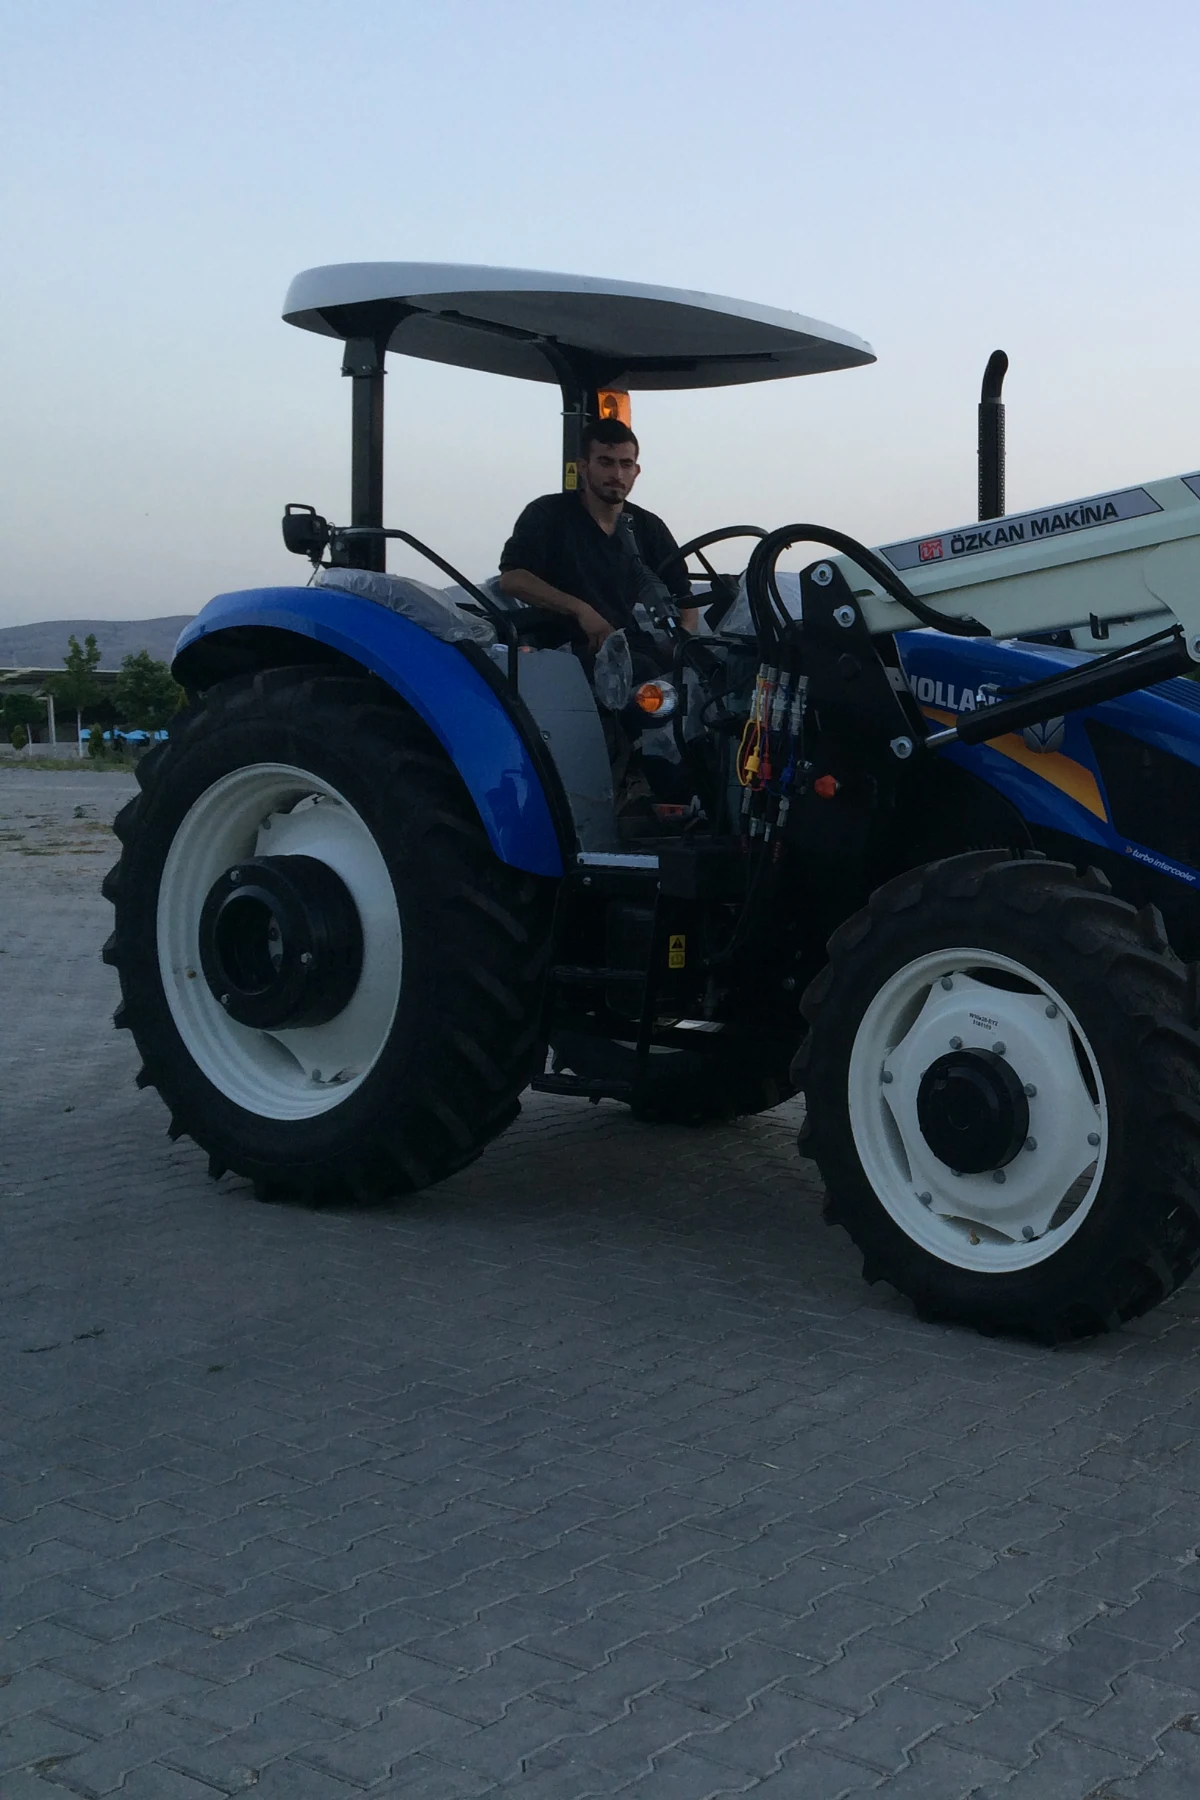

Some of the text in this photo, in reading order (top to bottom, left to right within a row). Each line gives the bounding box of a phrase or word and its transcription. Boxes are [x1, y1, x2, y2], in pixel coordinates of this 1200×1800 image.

[950, 524, 1024, 555] ÖZKAN
[1030, 502, 1119, 537] MAKİNA
[1132, 848, 1197, 882] turbo intercooler
